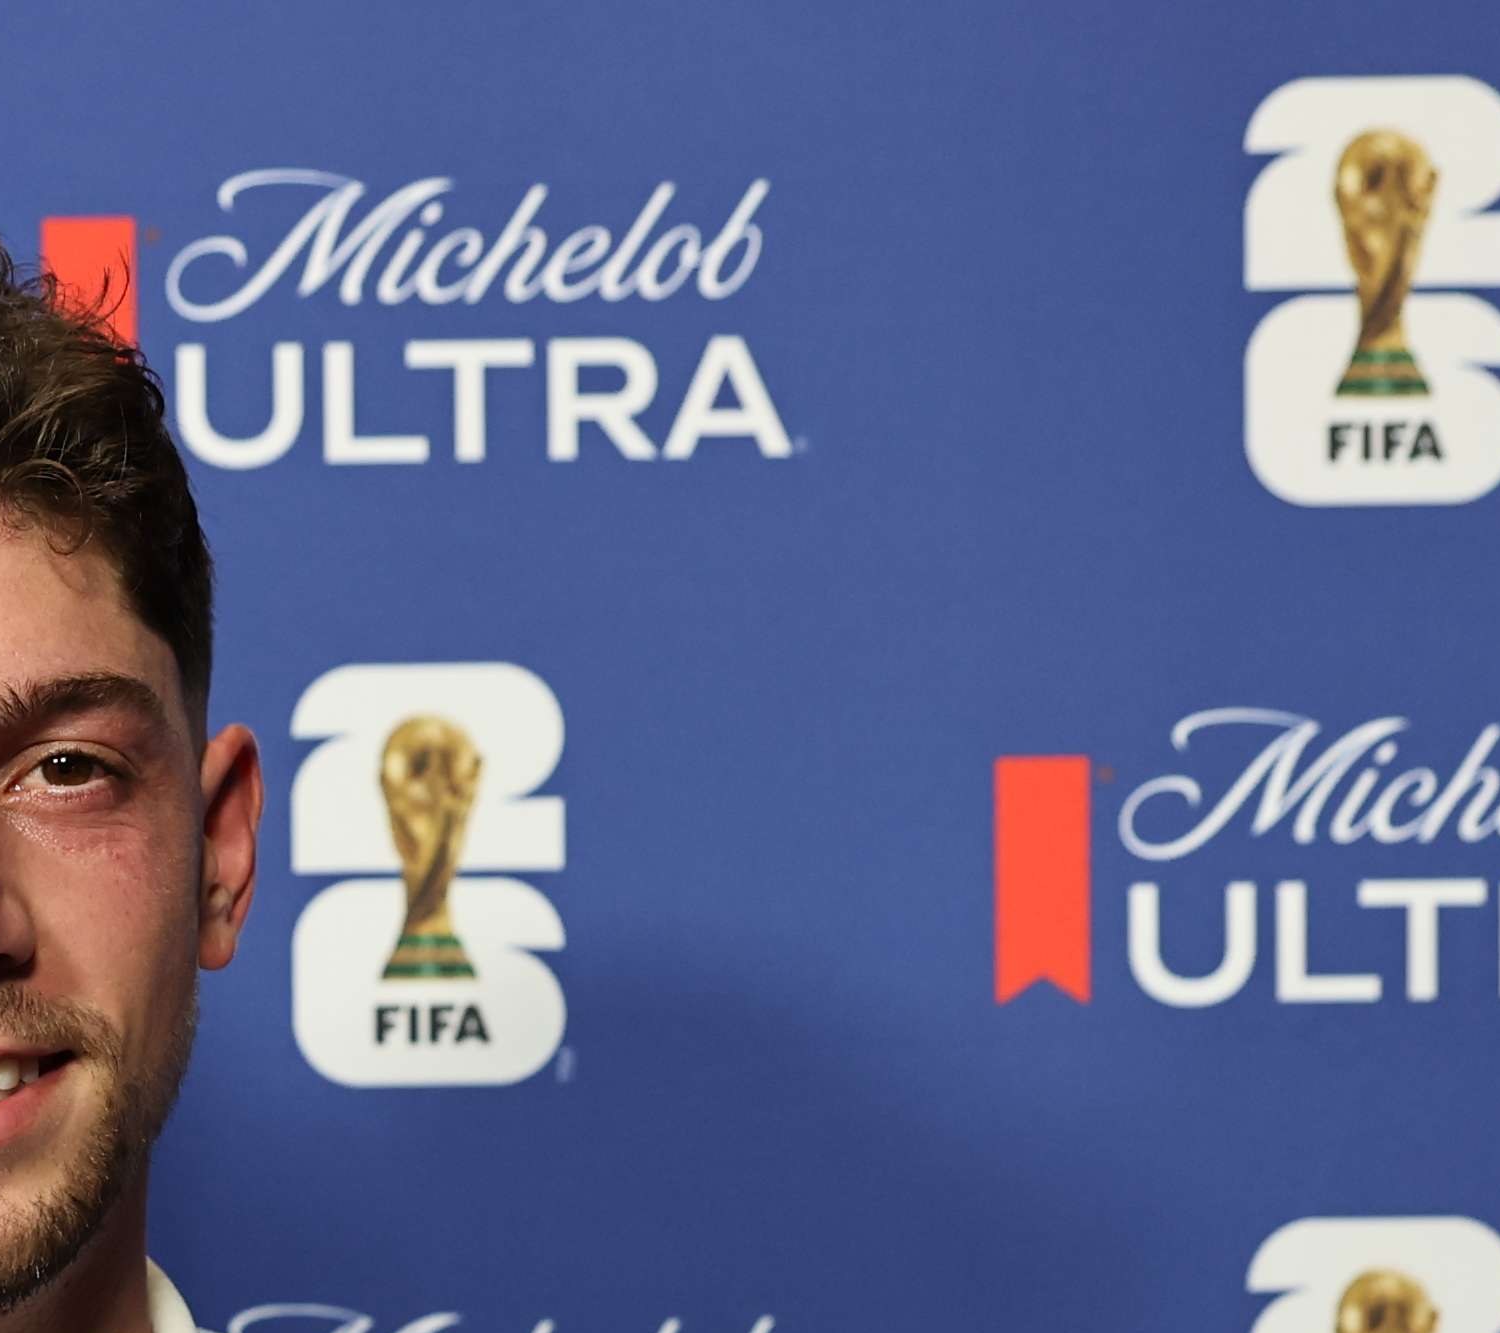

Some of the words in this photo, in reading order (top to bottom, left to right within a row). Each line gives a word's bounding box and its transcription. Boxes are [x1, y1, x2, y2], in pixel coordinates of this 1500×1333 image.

[167, 171, 767, 321] Michelob
[176, 337, 790, 468] ULTRA
[1328, 422, 1443, 462] FIFA
[374, 1004, 491, 1045] FIFA
